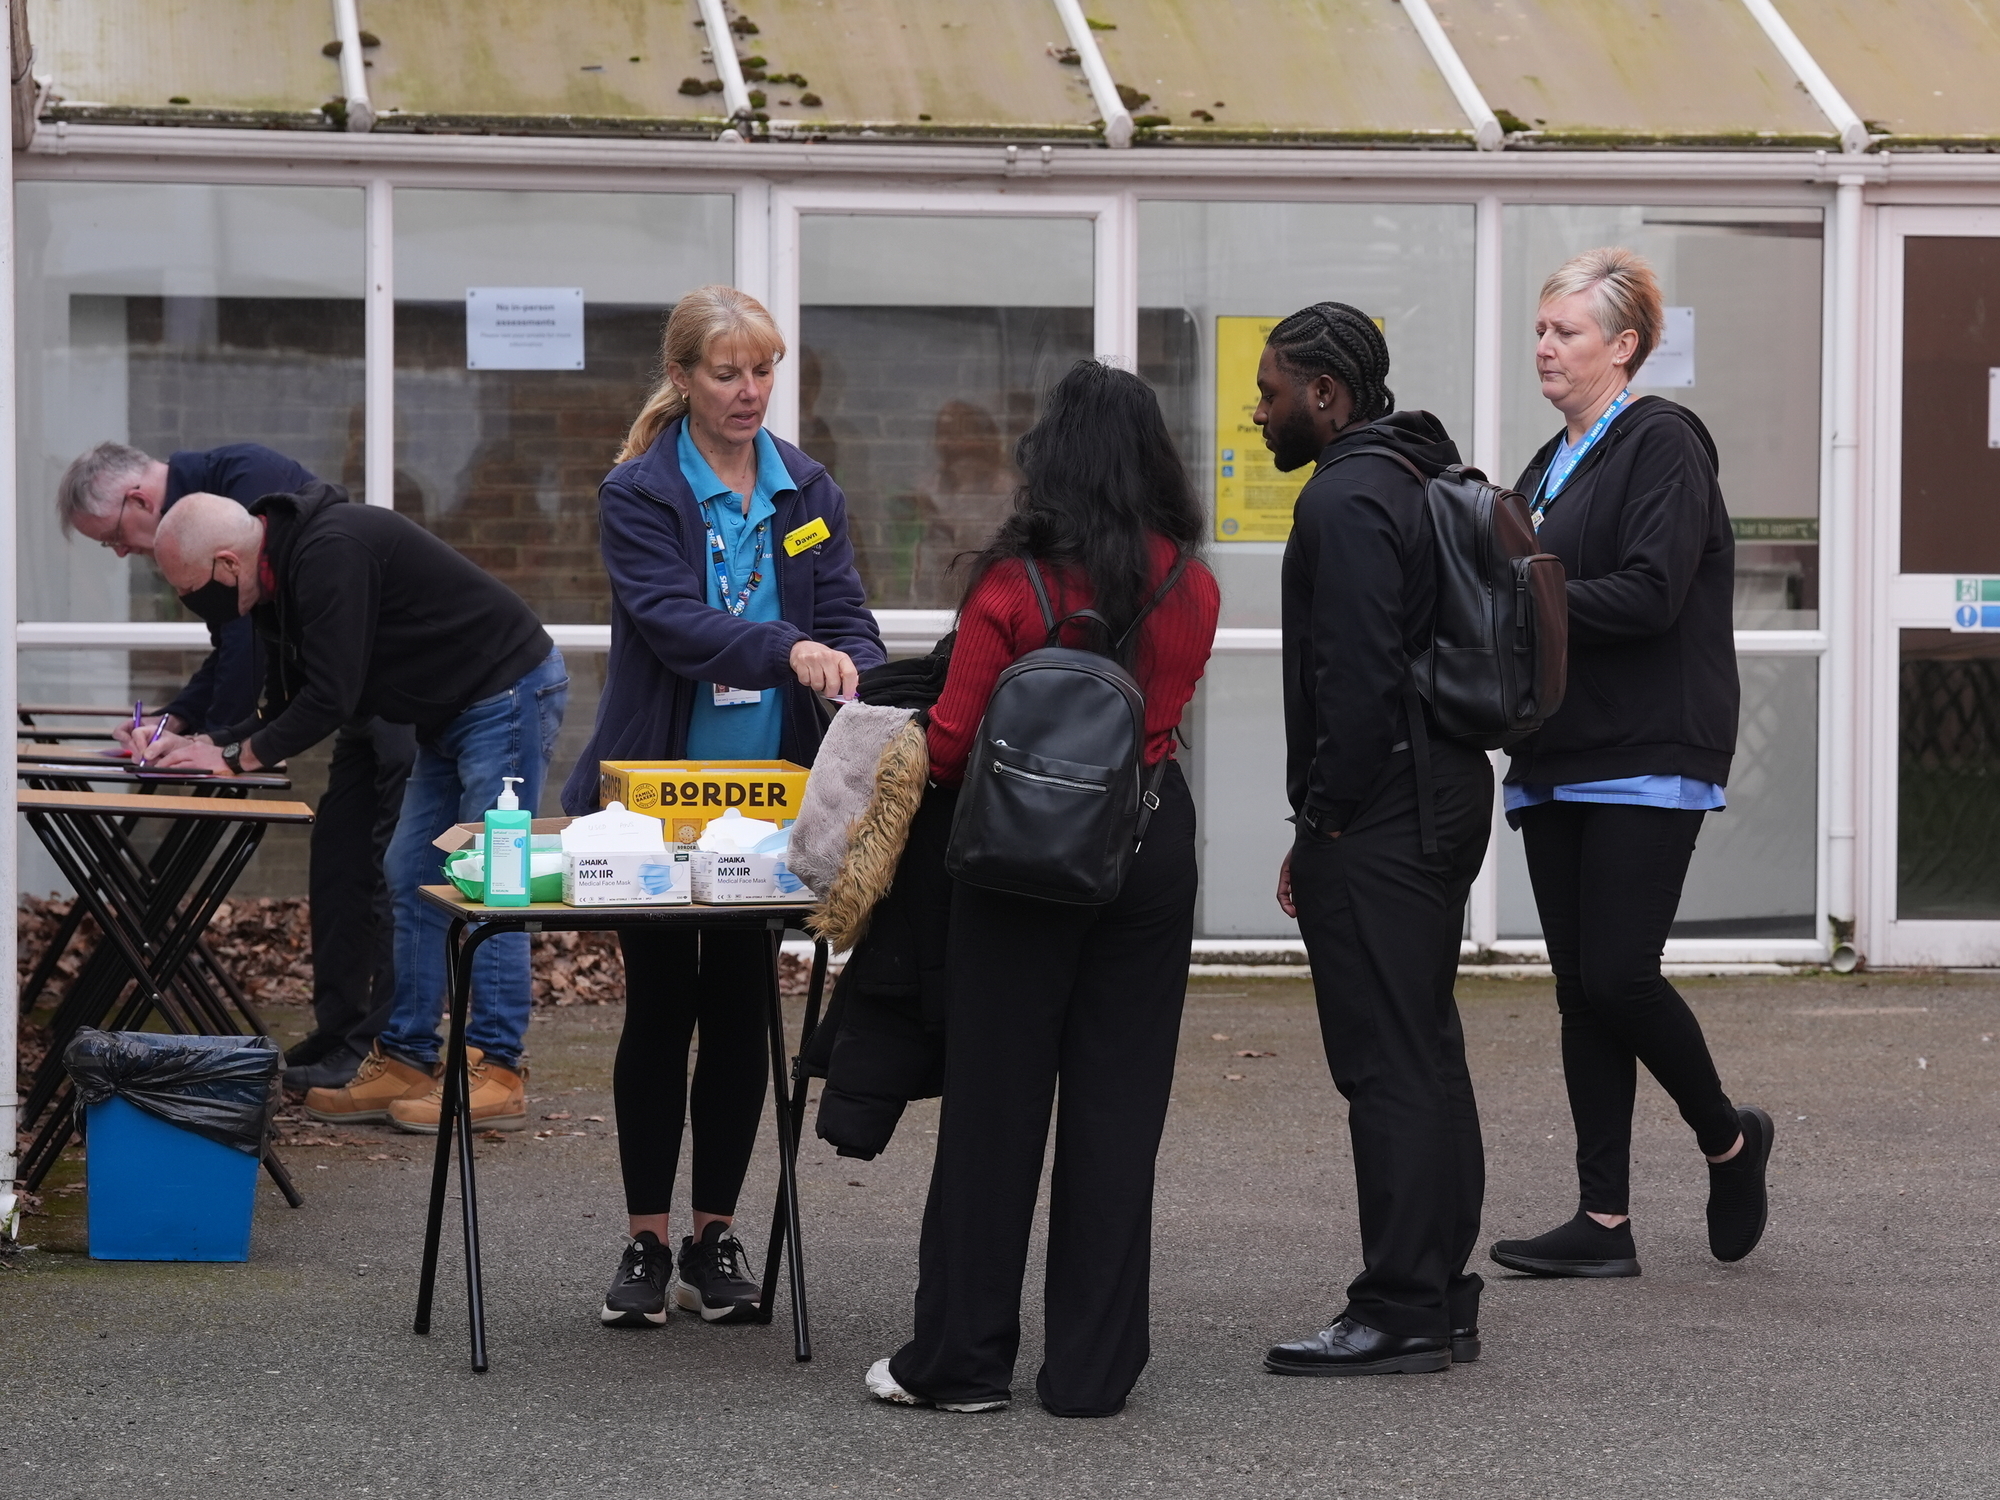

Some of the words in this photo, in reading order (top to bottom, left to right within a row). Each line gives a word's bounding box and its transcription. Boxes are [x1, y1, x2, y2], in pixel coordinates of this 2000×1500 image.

[496, 303, 509, 312] No
[511, 303, 555, 313] in-person
[496, 319, 556, 327] assessments
[1565, 459, 1577, 475] NHS
[1578, 441, 1590, 456] NHS
[1590, 422, 1603, 438] NHS
[1603, 404, 1617, 419] NHS
[1616, 391, 1628, 404] NHS
[795, 532, 818, 546] Dawn
[635, 789, 654, 798] FAMILY
[636, 793, 656, 802] BAKERS
[661, 781, 788, 807] BORDER
